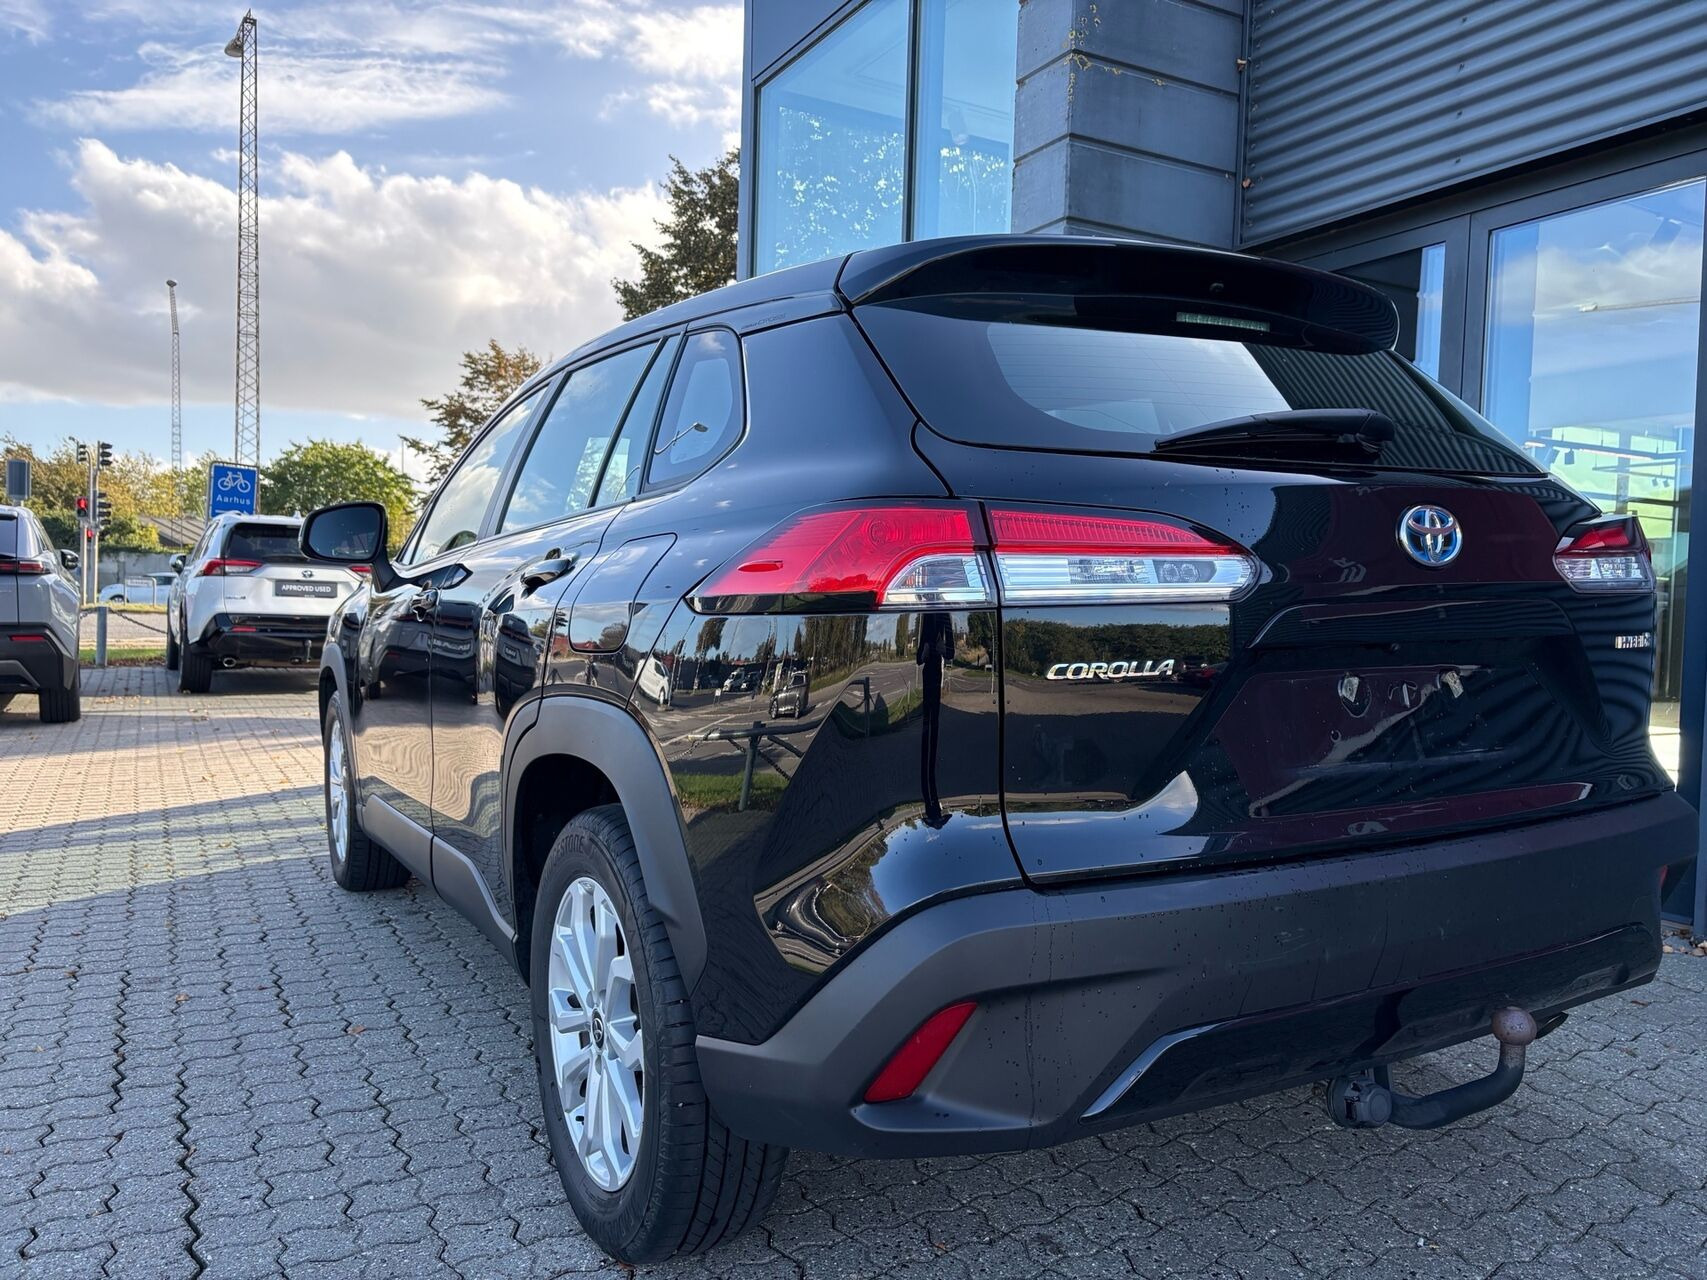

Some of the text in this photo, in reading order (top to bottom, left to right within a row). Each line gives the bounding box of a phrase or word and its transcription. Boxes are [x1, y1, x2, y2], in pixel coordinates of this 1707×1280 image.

[216, 494, 251, 505] Aarhus
[281, 584, 314, 592] APPROVED
[1046, 659, 1175, 680] COROLLA
